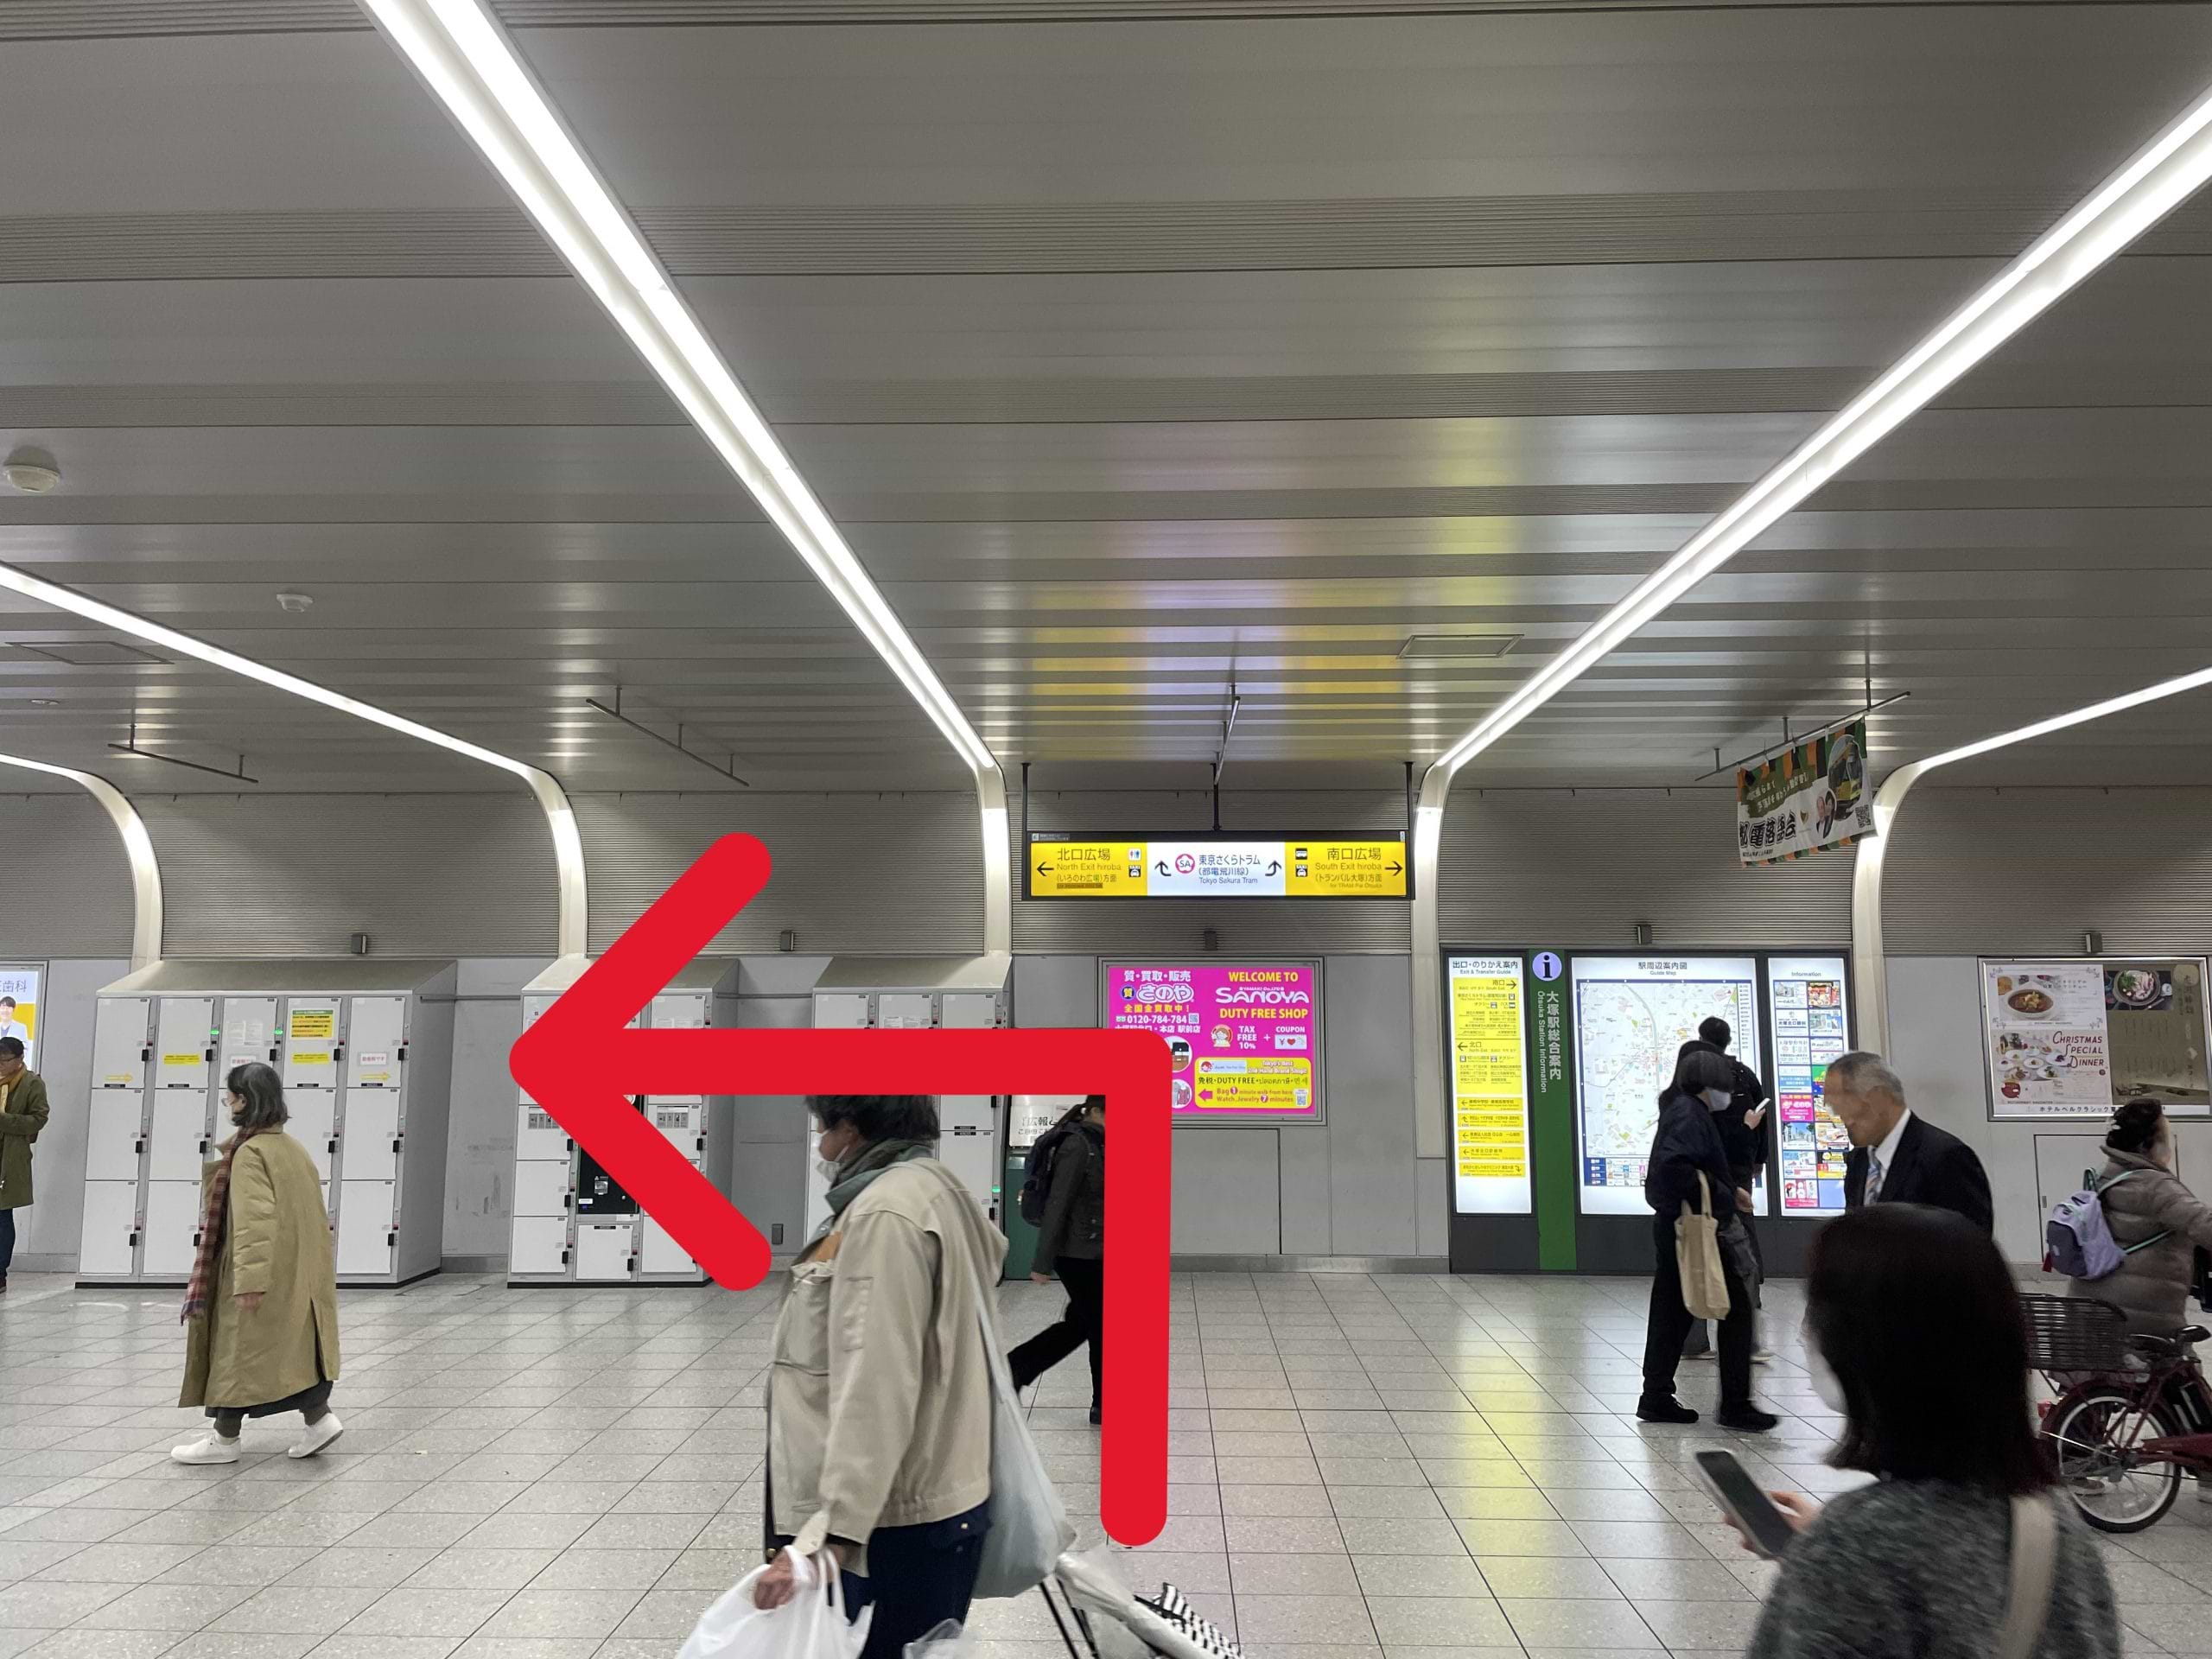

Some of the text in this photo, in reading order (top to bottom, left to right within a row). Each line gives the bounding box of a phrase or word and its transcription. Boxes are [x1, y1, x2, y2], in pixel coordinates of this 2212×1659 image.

[1057, 848, 1111, 861] 北口広場
[1198, 855, 1261, 866] 東京さくらトラム
[1326, 848, 1382, 861] 南口広場
[1179, 860, 1192, 868] SA
[1315, 862, 1382, 871] South Exit hiroba
[1198, 867, 1249, 876] (都電荒川線)
[1124, 970, 1192, 982] 質・買取・販売
[1228, 971, 1299, 982] WELCOME TO
[1137, 983, 1193, 1002] さのや
[1215, 987, 1310, 1004] SANOYA
[1127, 1015, 1187, 1024] 0120-784-784
[1219, 1008, 1308, 1019] DUTY FREE SHOP
[1178, 1025, 1201, 1033] 駅前店
[1546, 990, 1561, 1080] 大塚駅総合案内
[2052, 1031, 2103, 1044] CHRISTMAS
[2063, 1044, 2103, 1057] SPECIAL
[2067, 1055, 2104, 1068] DINNER
